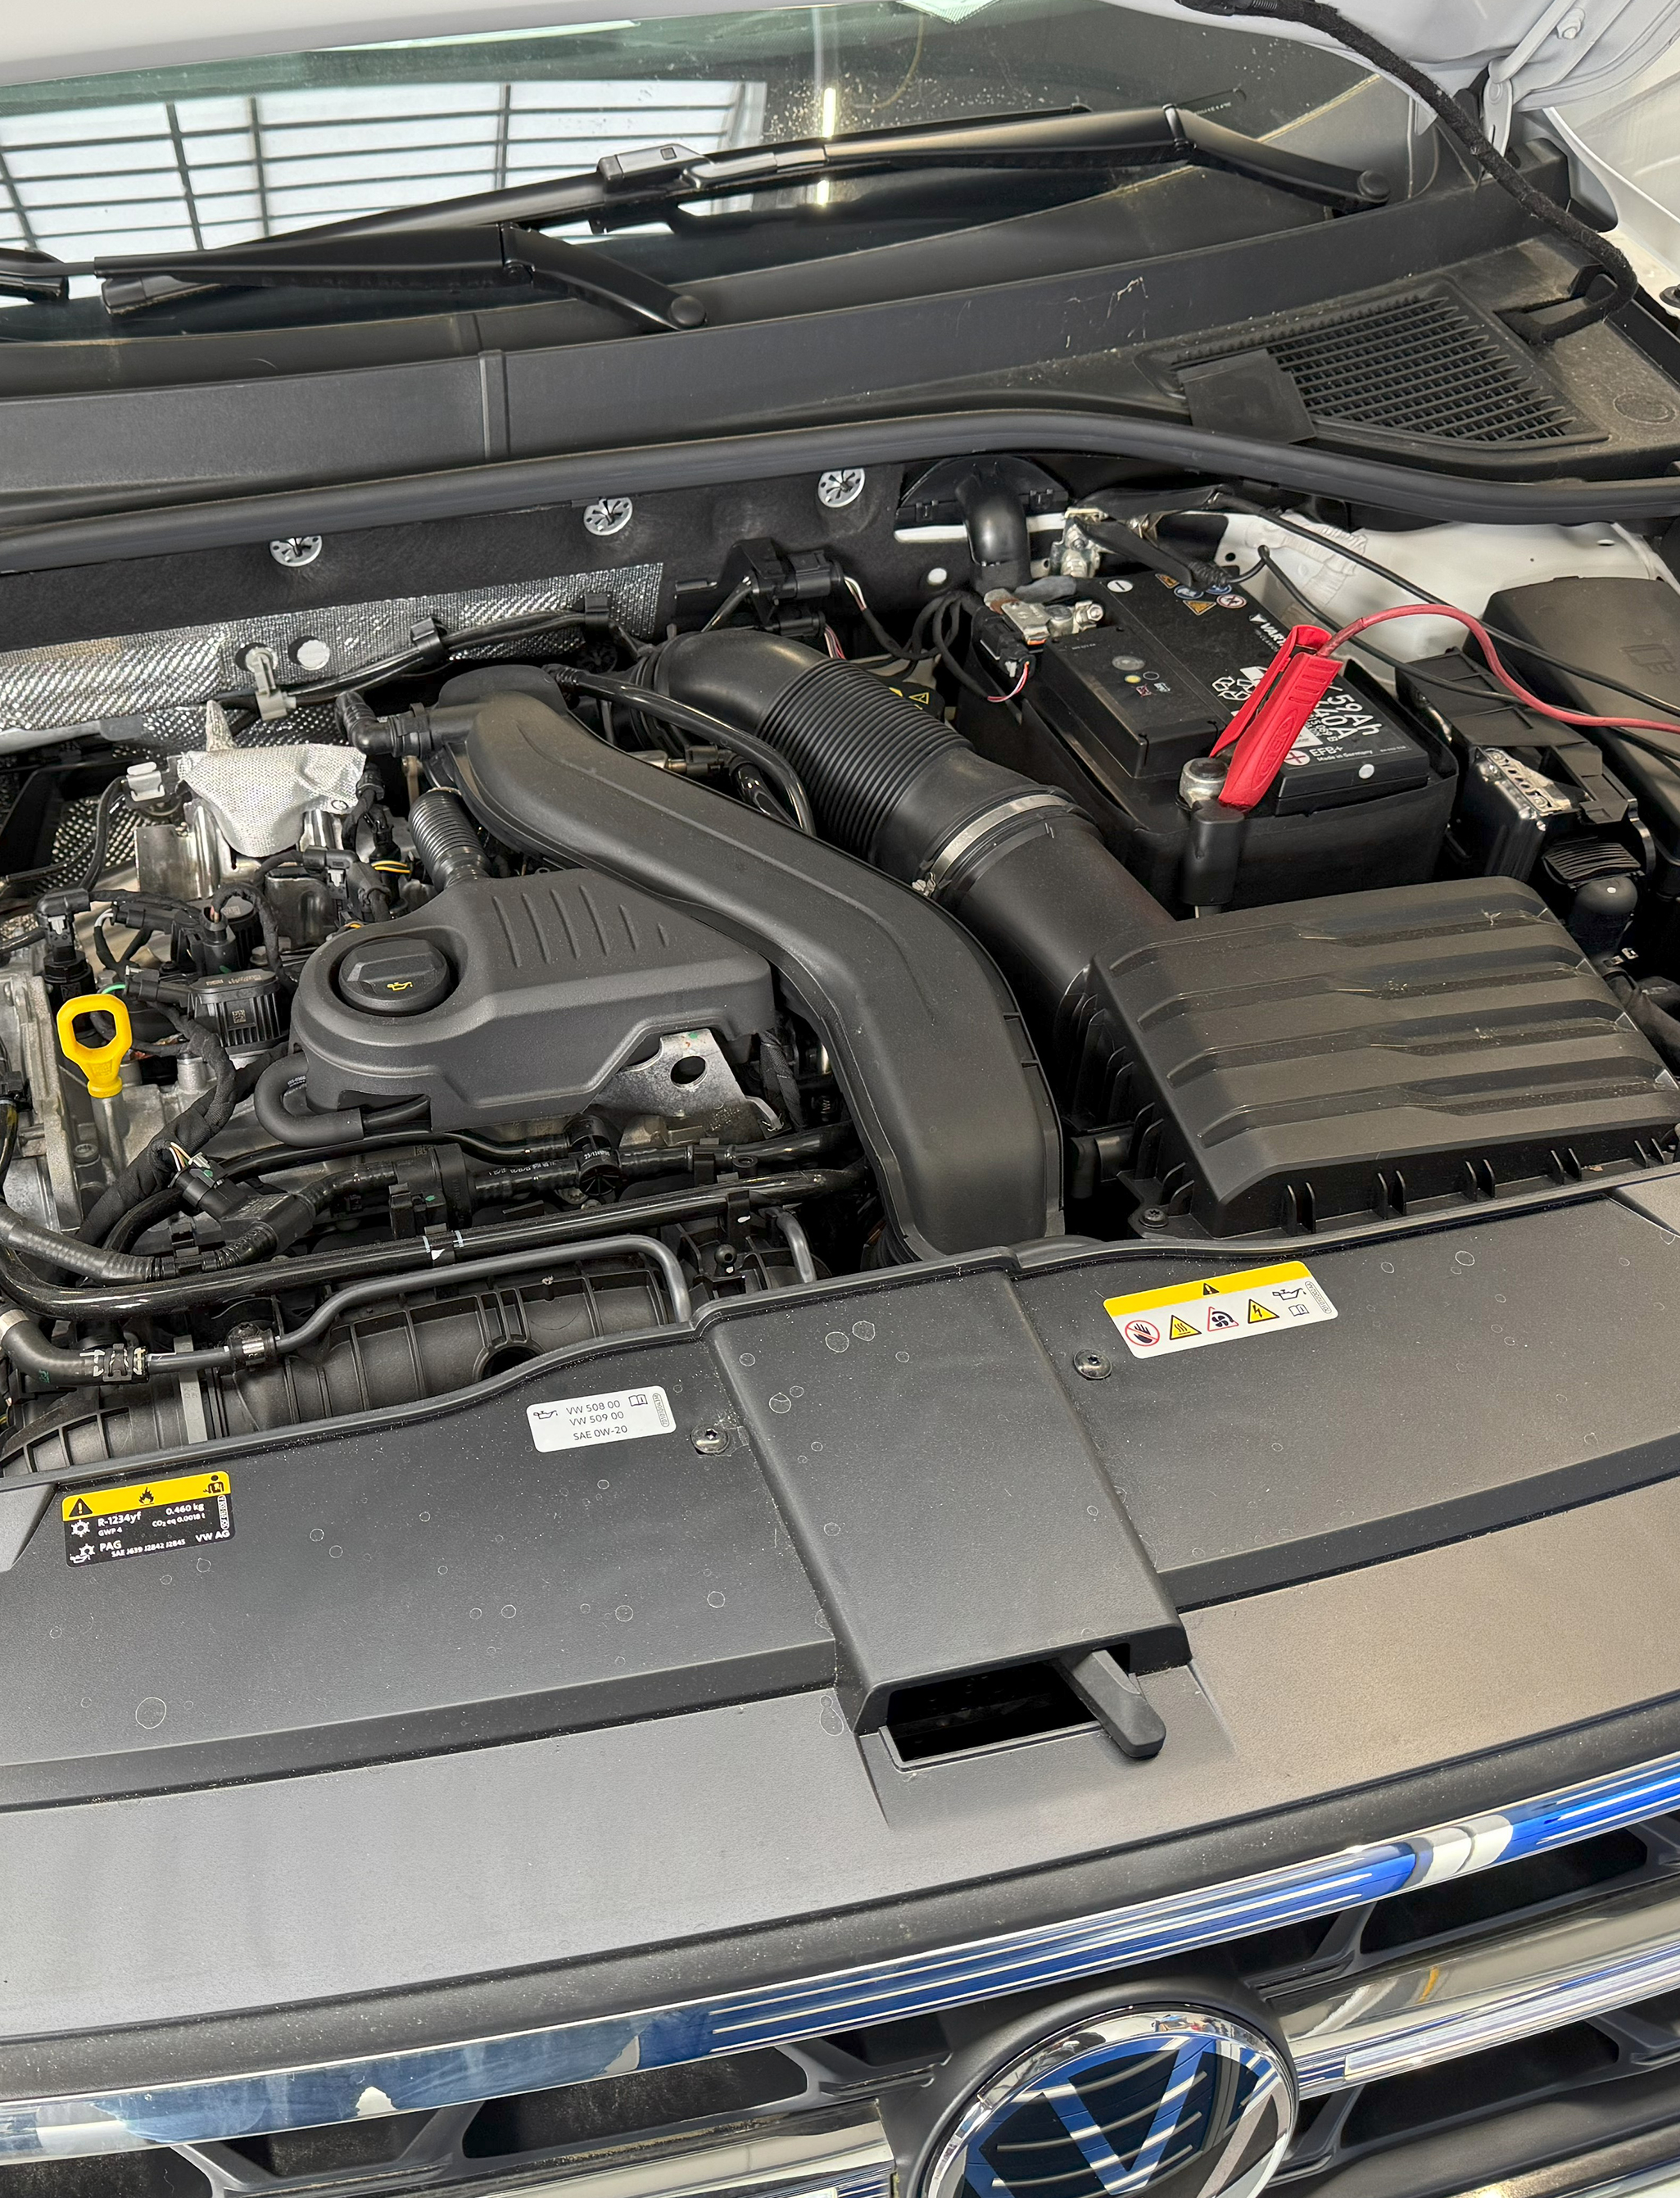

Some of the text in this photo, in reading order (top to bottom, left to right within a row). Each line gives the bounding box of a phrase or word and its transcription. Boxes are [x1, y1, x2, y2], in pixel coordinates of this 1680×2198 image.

[1260, 623, 1287, 646] VART
[1327, 694, 1383, 736] 59Ah
[1309, 746, 1343, 757] EFB+
[1343, 750, 1374, 758] Germany
[565, 1399, 622, 1416] VW 508 00
[568, 1411, 625, 1426] VW 509 00
[573, 1425, 628, 1441] SAE 0W-20
[165, 1502, 205, 1516] 0.460 kg
[97, 1511, 142, 1528] R-1234yf
[176, 1513, 201, 1523] 0.0018
[97, 1528, 116, 1537] GWP
[195, 1530, 230, 1543] VW AG
[99, 1540, 122, 1552] PAG
[111, 1539, 186, 1558] SAE J639 J2842 J2845
